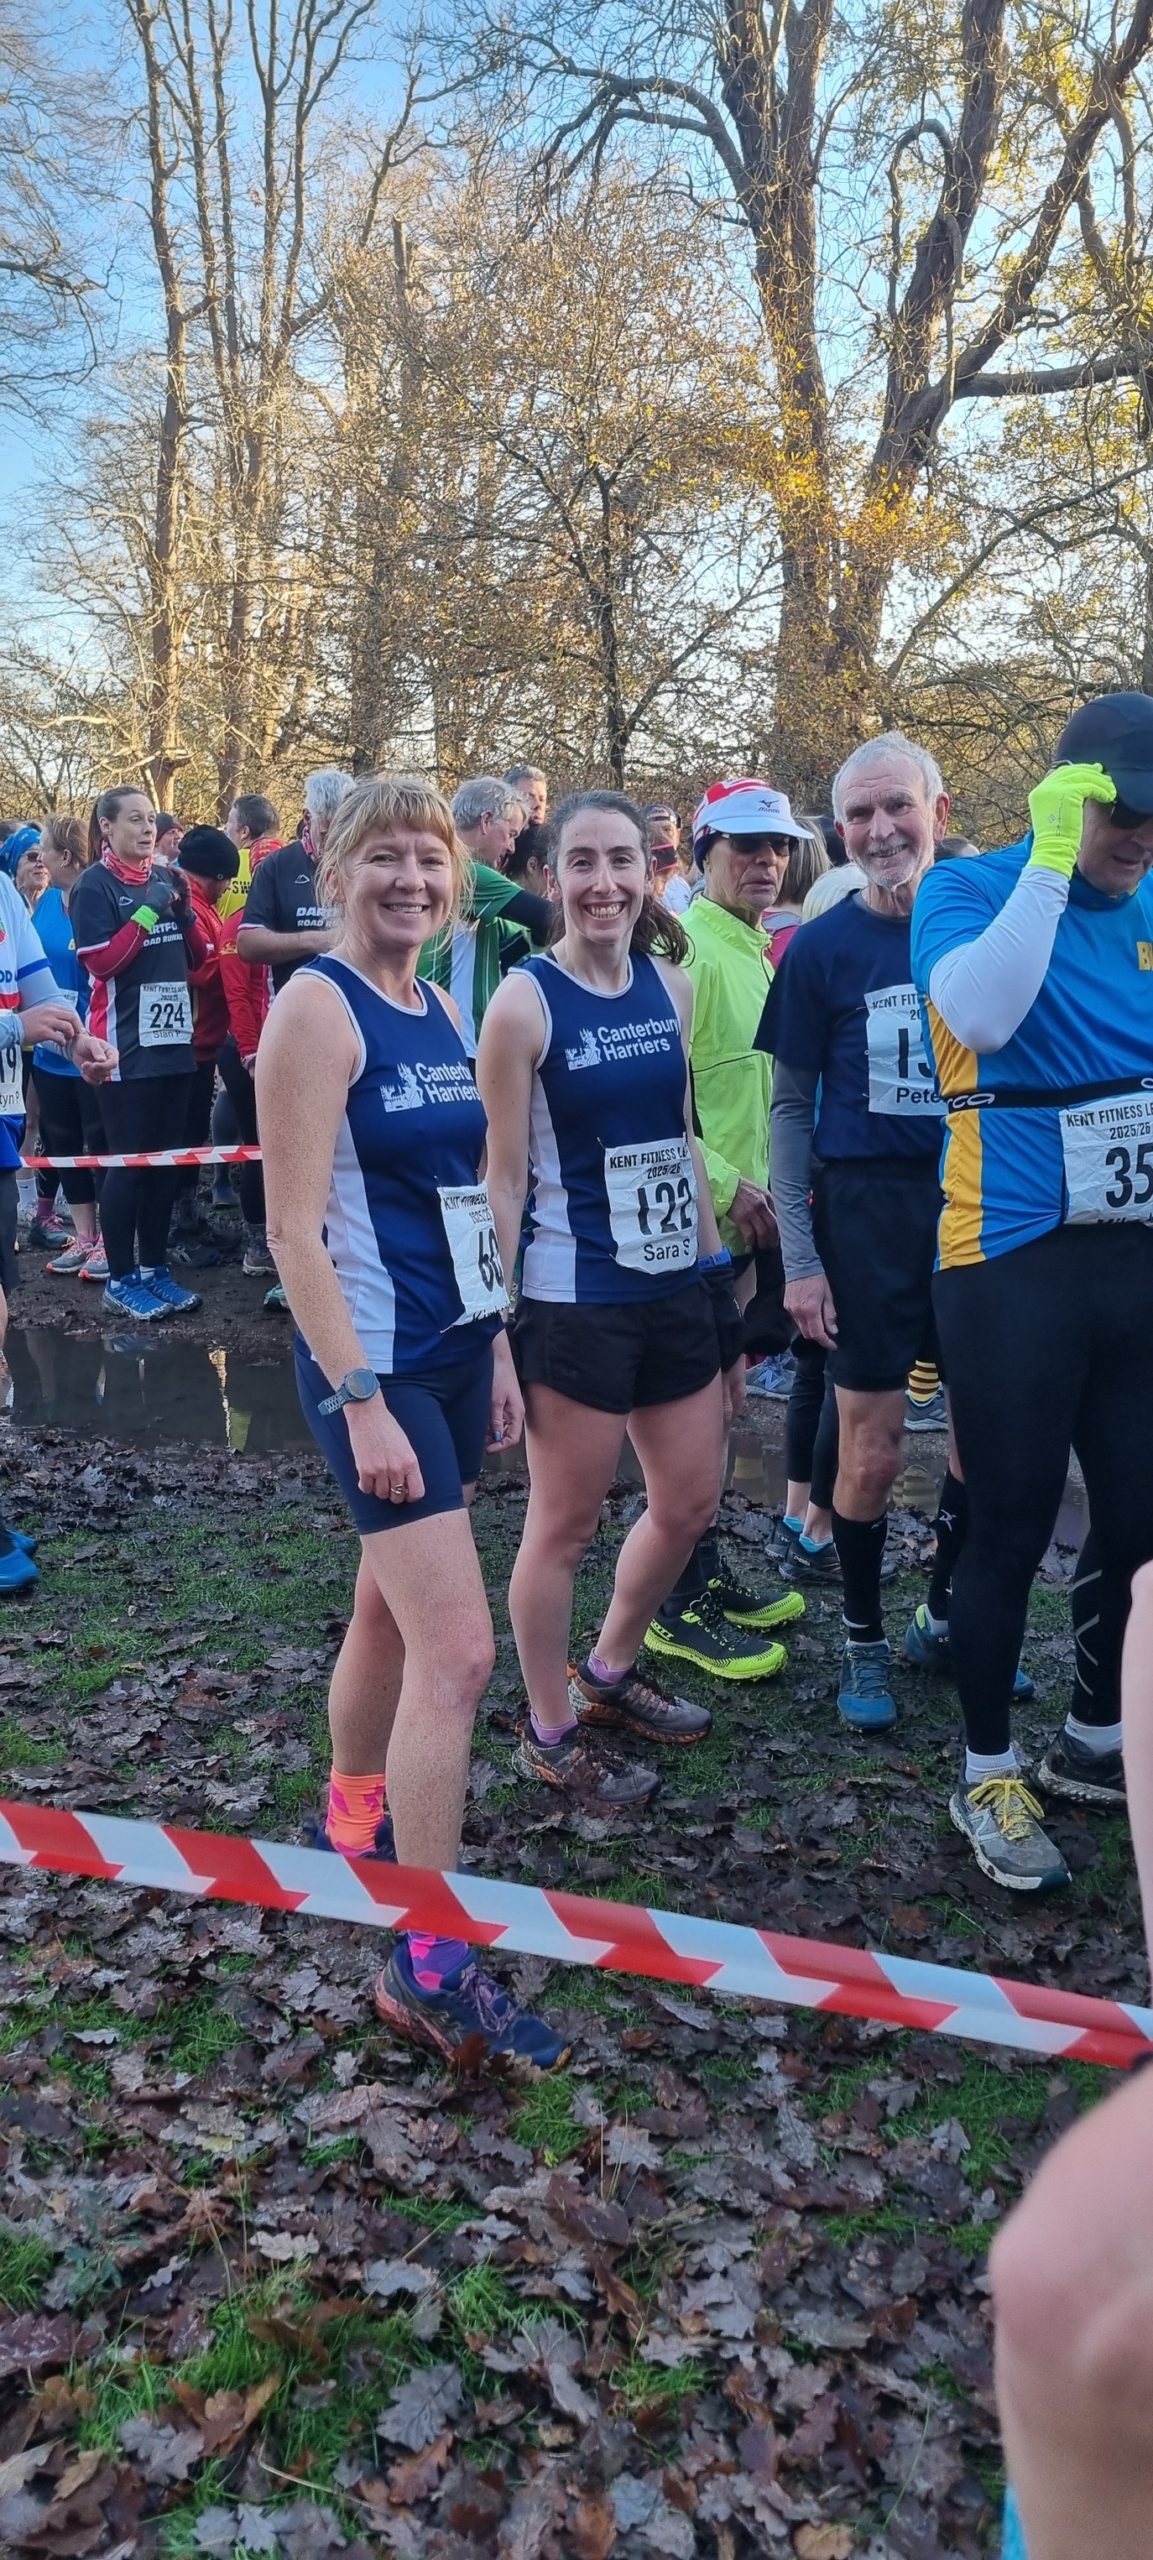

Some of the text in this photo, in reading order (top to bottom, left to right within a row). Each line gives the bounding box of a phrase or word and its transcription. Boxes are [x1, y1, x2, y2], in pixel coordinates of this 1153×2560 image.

[149, 921, 178, 935] RTFO
[872, 995, 897, 1009] KENT
[150, 1002, 184, 1029] 224
[597, 1018, 679, 1043] Canterbury
[602, 1038, 671, 1061] Harriers
[1066, 1112, 1095, 1128] KENT
[1099, 1104, 1143, 1124] FITNESS
[1110, 1122, 1150, 1140] 2025/26
[608, 1154, 638, 1169] KENT
[640, 1147, 676, 1165] FITNESS
[647, 1162, 681, 1180] 2025/26
[1106, 1142, 1153, 1208] 35
[637, 1177, 692, 1236] 122
[643, 1238, 691, 1262] Sara S
